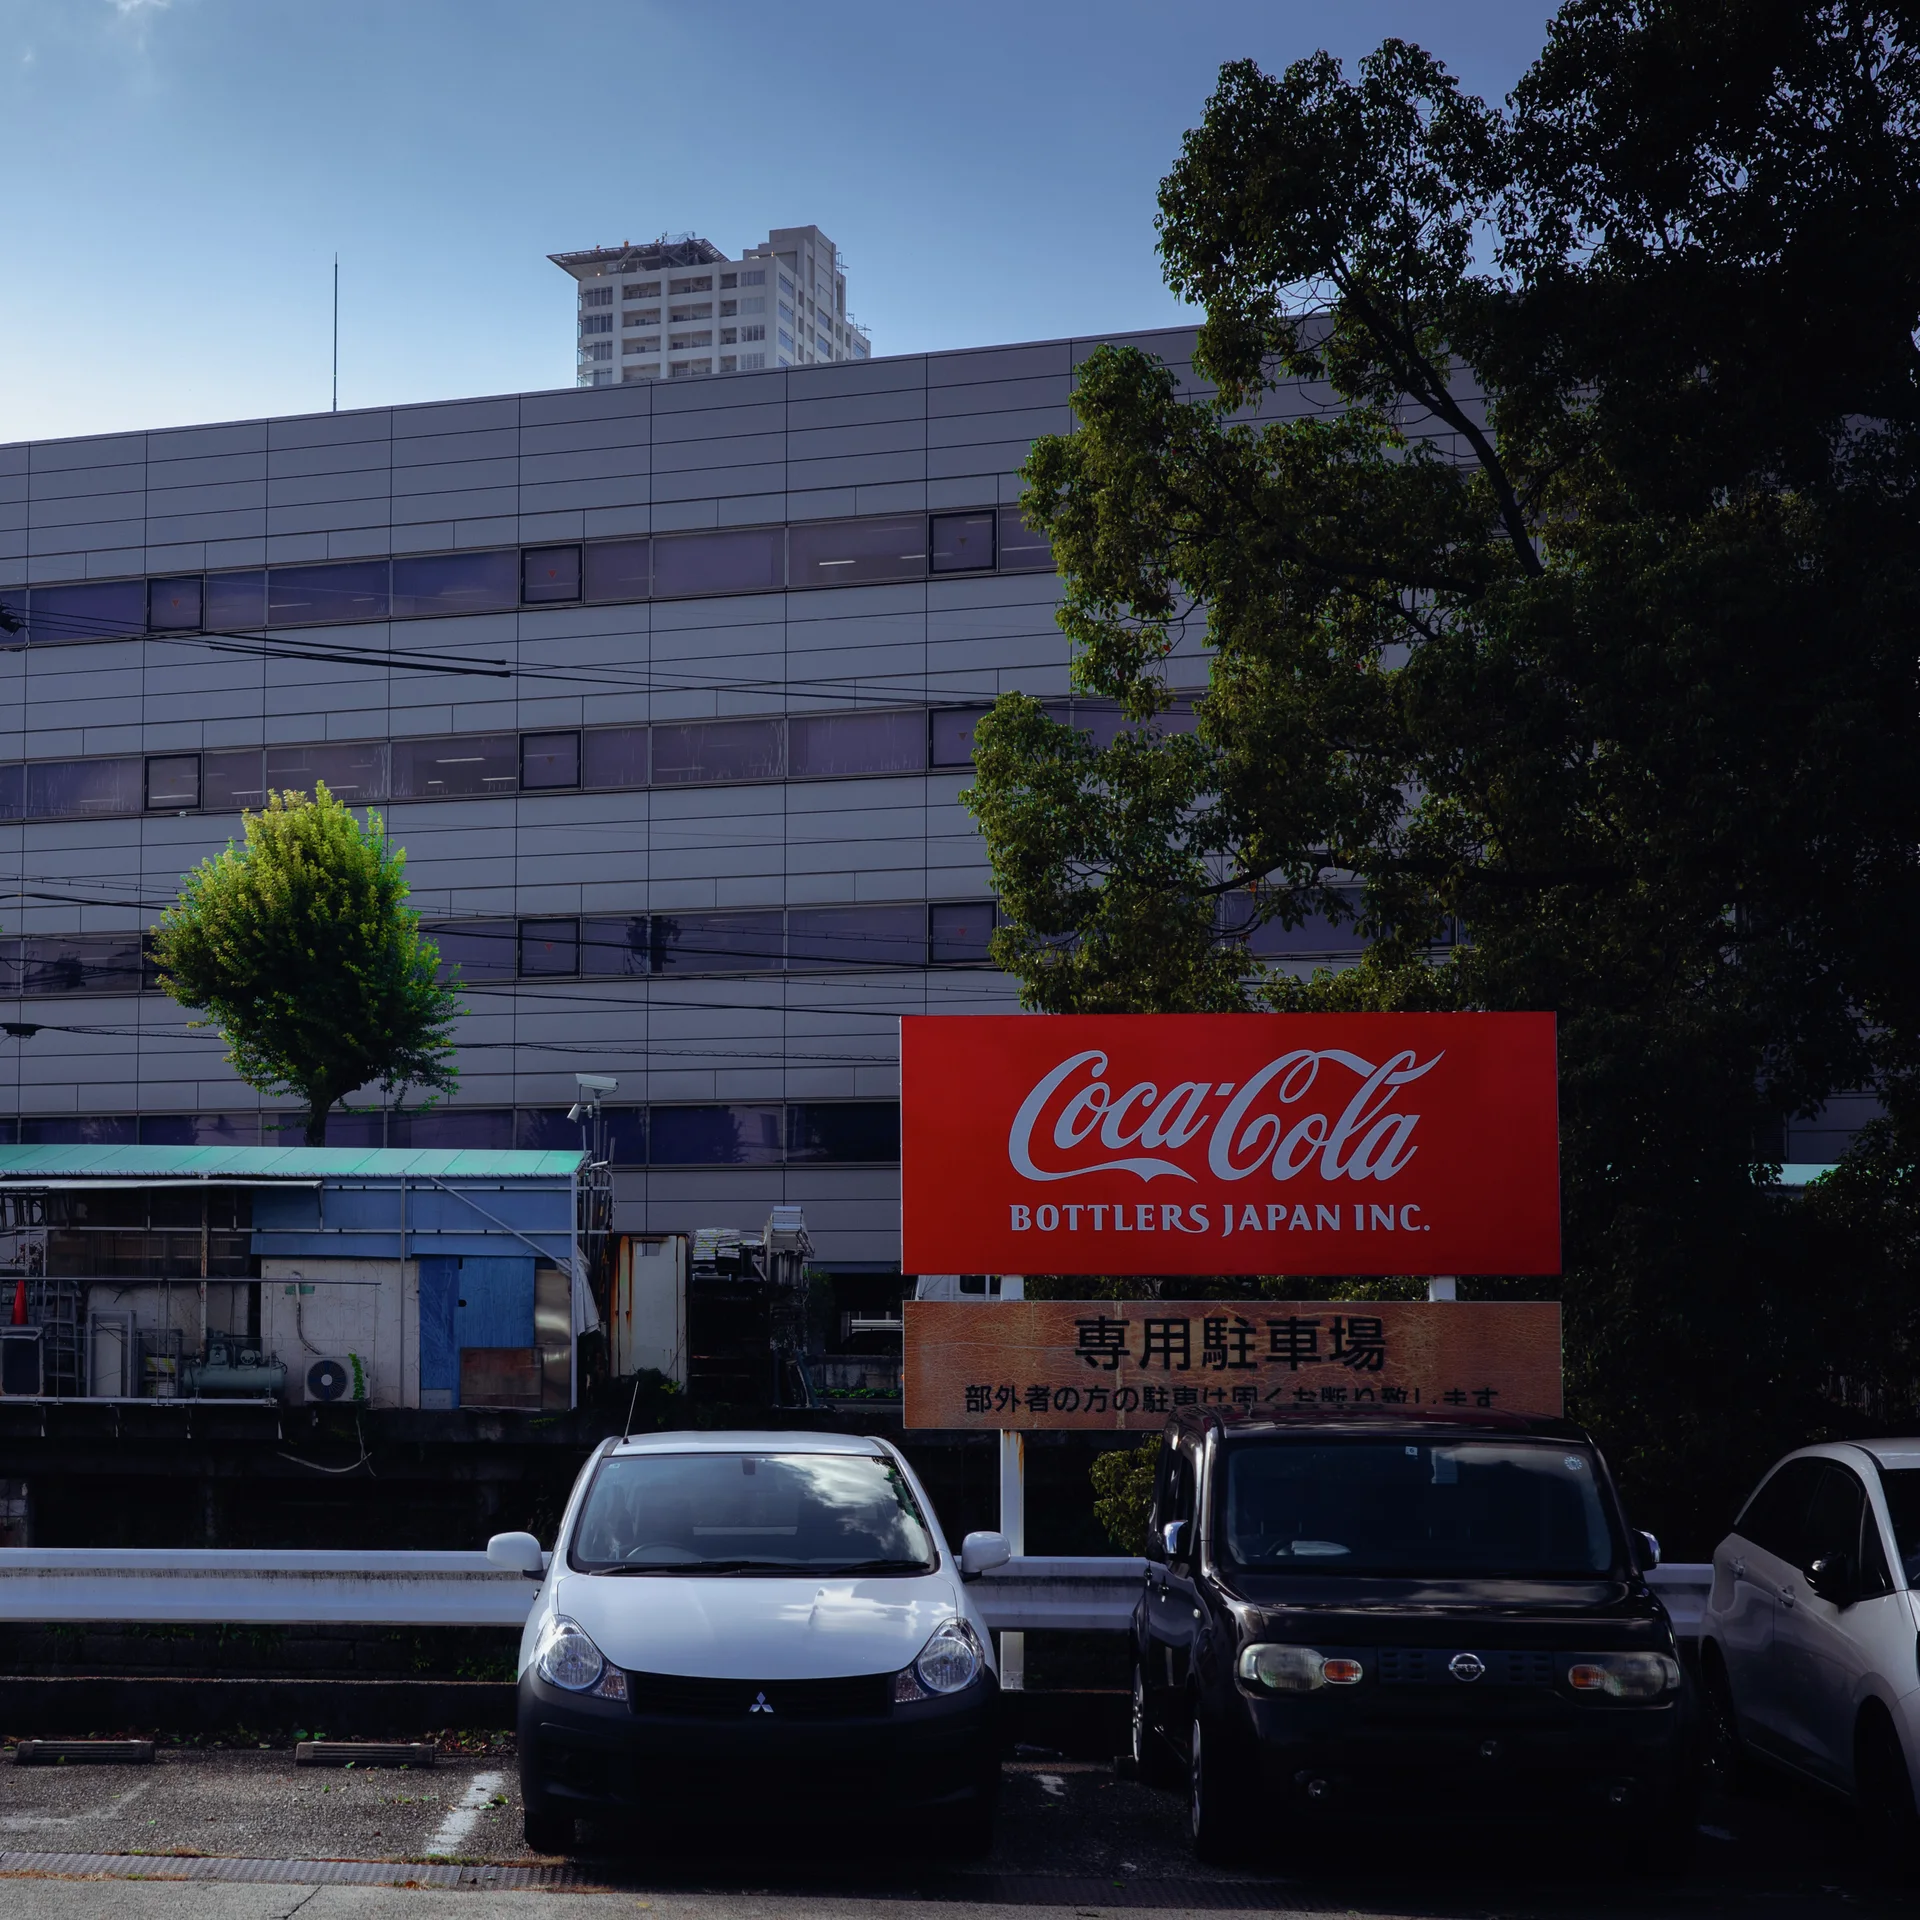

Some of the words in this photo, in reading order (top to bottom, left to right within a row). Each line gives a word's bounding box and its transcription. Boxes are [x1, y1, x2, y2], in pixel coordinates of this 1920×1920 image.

[1008, 1049, 1446, 1183] Coca-Cola
[1009, 1203, 1210, 1233] BOTTLERS
[1221, 1204, 1341, 1238] JAPAN
[1353, 1203, 1431, 1233] INC.
[1074, 1315, 1387, 1372] 専用駐車場
